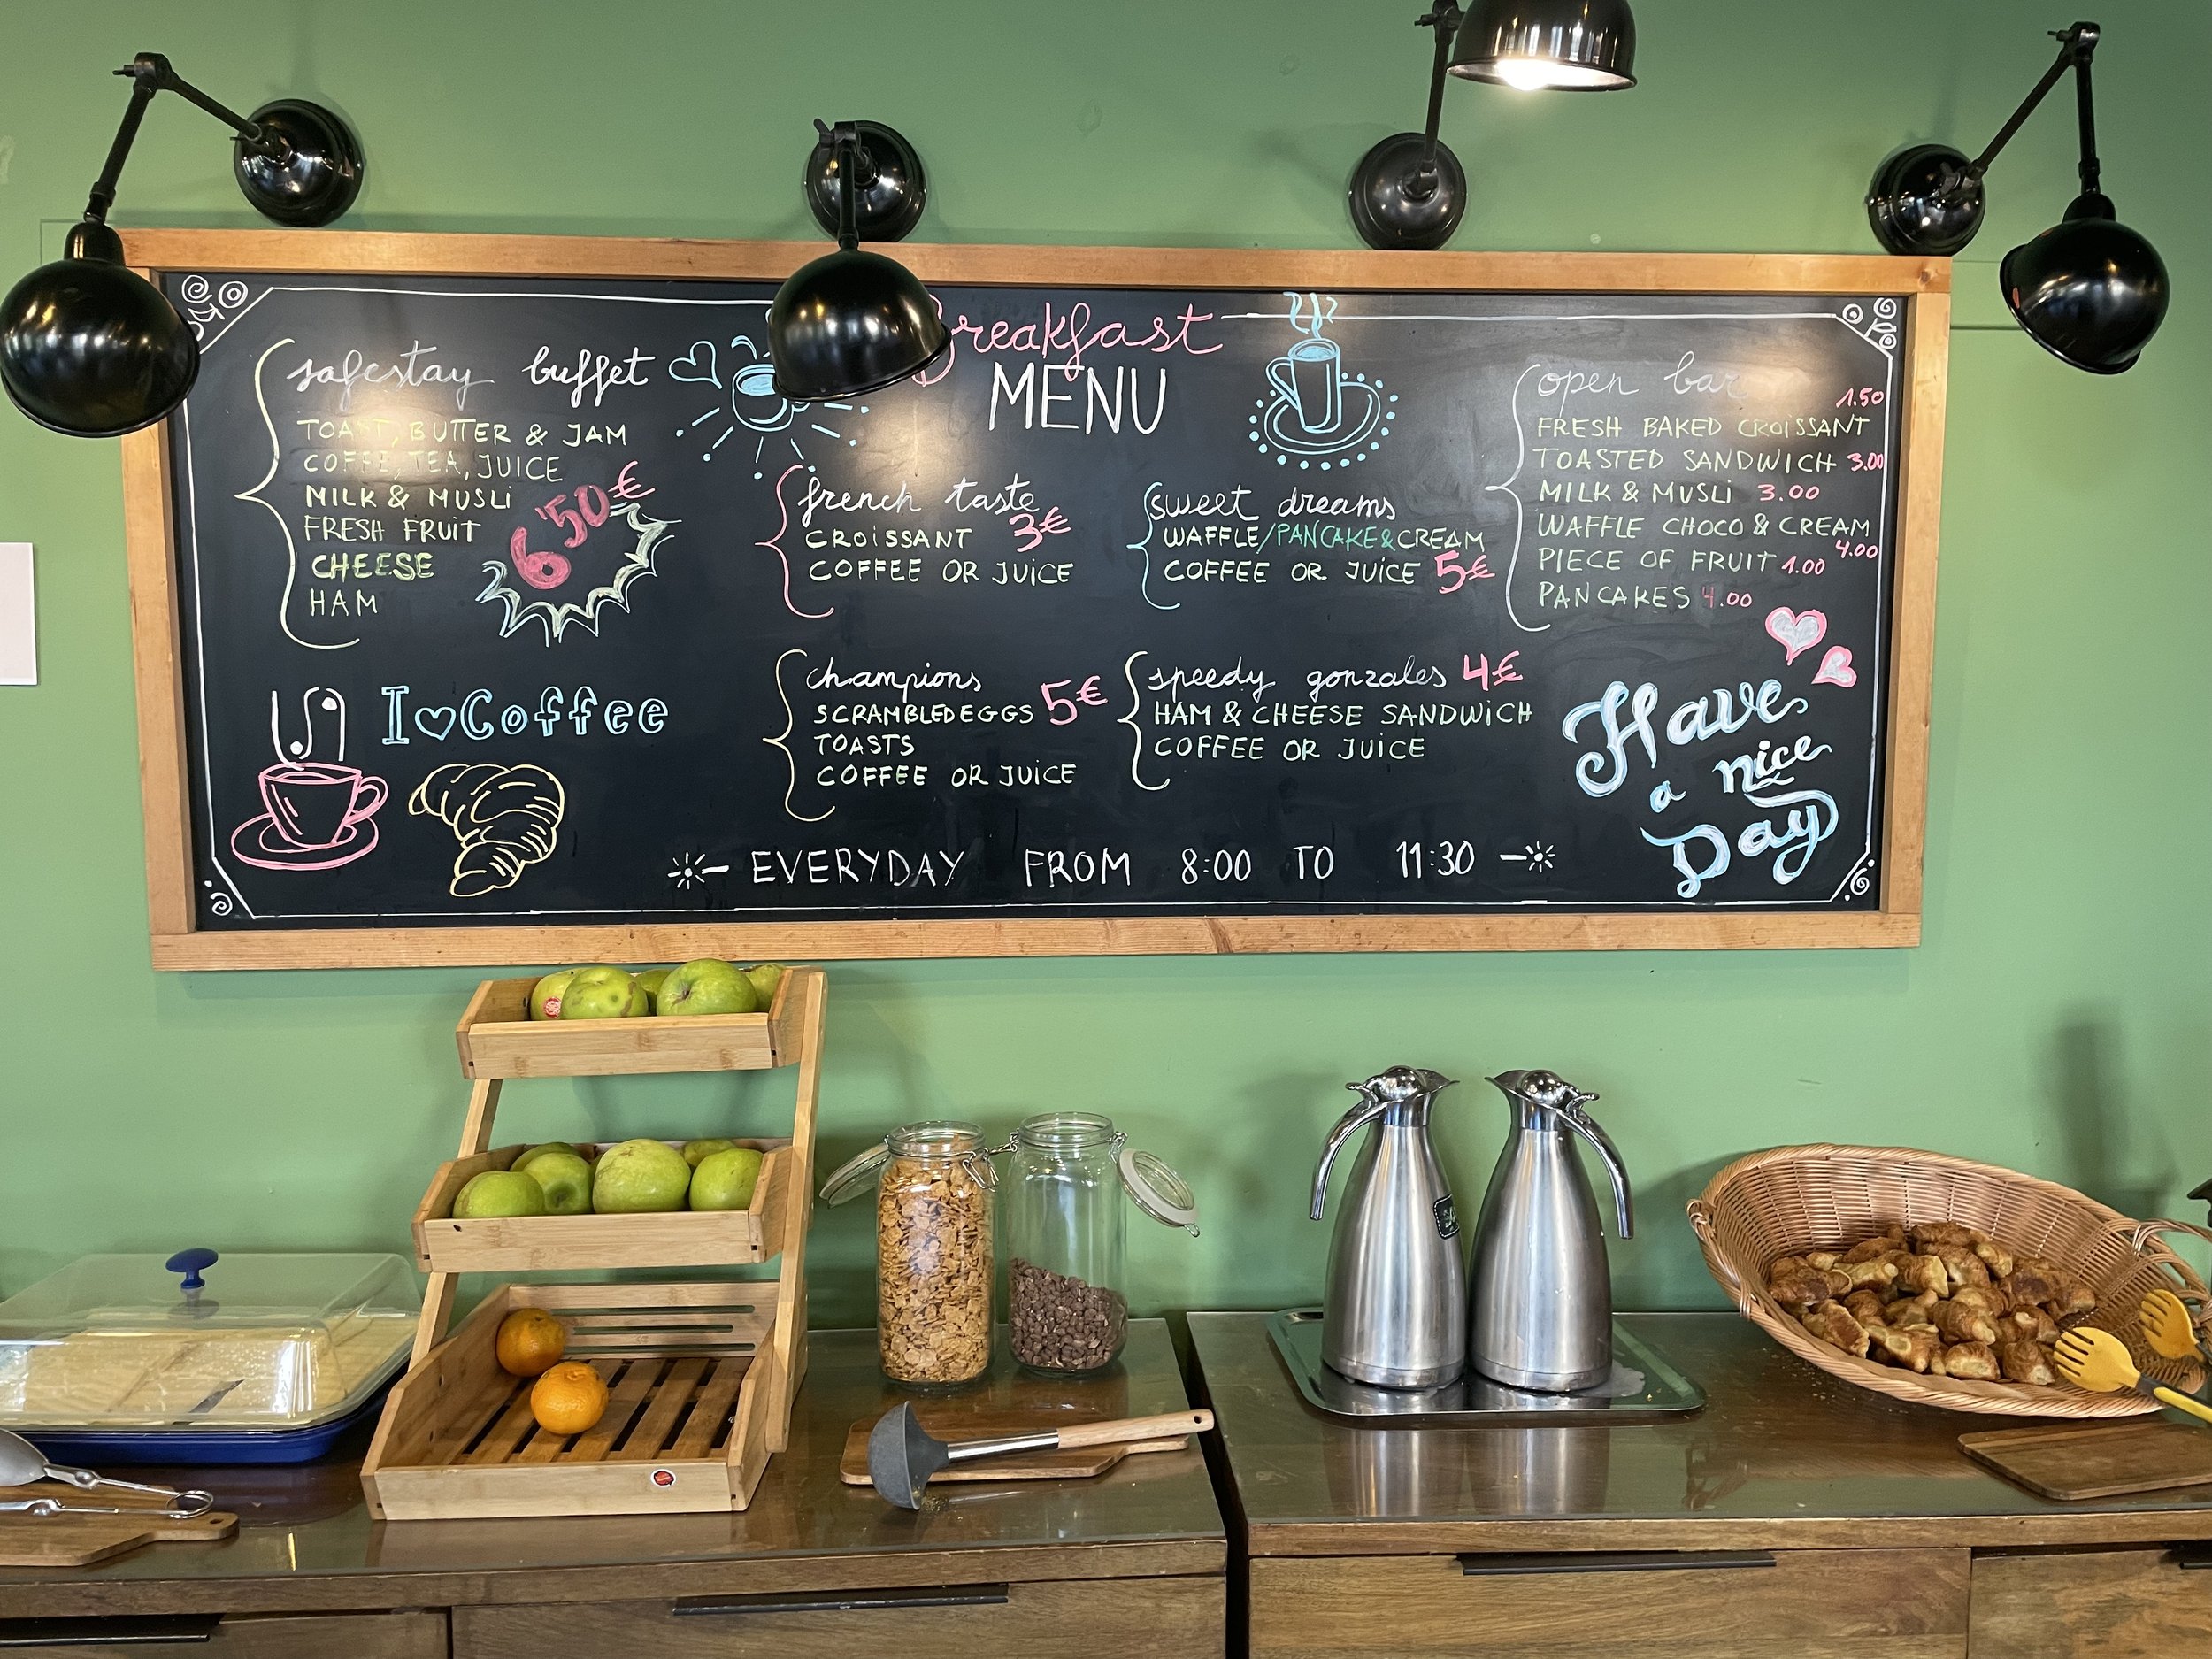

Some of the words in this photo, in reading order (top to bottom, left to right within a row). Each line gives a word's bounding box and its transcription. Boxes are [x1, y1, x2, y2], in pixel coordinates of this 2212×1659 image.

[521, 345, 656, 409] buffet
[1537, 369, 1640, 417] open
[1663, 350, 1748, 399] bar
[988, 361, 1166, 434] MENU
[1835, 388, 1884, 408] 1.50
[409, 419, 511, 444] BUTTER
[525, 424, 549, 447] &
[563, 423, 627, 448] JAM
[1538, 416, 1623, 438] FRESH
[1643, 415, 1722, 439] BAKED
[478, 453, 564, 483] JUICE
[1532, 448, 1664, 471] TOASTED
[1683, 449, 1837, 473] SANDWICH
[1846, 452, 1884, 472] 3.00
[306, 485, 377, 509] MILK
[388, 485, 411, 511] &
[798, 475, 922, 528] french
[944, 472, 1041, 515] taste
[1149, 483, 1260, 521] sweet
[1278, 486, 1397, 521] dreams
[1540, 479, 1612, 503] MILK
[1622, 480, 1640, 503] &
[1757, 484, 1821, 503] 3.00
[304, 515, 384, 542] FRESH
[1009, 506, 1071, 553] 3€
[1537, 513, 1645, 539] WAFFLE
[1662, 517, 1743, 537] CHOCO
[1752, 513, 1769, 537] &
[1778, 515, 1870, 538] CREAM
[1538, 547, 1624, 573] PIECE
[1640, 549, 1675, 570] OF
[1691, 548, 1777, 572] FRUIT
[1781, 556, 1825, 576] 1.00
[1835, 539, 1878, 559] 4.00
[312, 552, 435, 583] CHEESE
[809, 558, 922, 583] COFFEE
[942, 559, 980, 584] OR
[1163, 559, 1271, 584] COFFEE
[1290, 560, 1327, 583] OR
[1433, 549, 1495, 594] 5€
[310, 588, 379, 617] HAM
[1540, 580, 1691, 610] PANCAKES
[1701, 587, 1753, 609] 4.00
[1148, 655, 1277, 703] speedy
[1306, 654, 1447, 703] gonzales
[1462, 650, 1525, 692] 4€
[380, 685, 411, 745] I
[460, 685, 670, 741] Coffee
[1039, 674, 1109, 726] 5€
[1154, 700, 1212, 726] HAM
[1224, 699, 1243, 728] &
[1251, 702, 1363, 727] CHEESE
[813, 733, 915, 757] TOASTS
[1153, 735, 1265, 760] COFFEE
[1282, 737, 1321, 762] OR
[1561, 679, 1809, 798] Have
[815, 764, 928, 787] COFFEE
[950, 764, 989, 787] OR
[1648, 780, 1686, 814] a
[1711, 735, 1832, 794] nice
[1640, 789, 1840, 899] Day
[750, 847, 964, 887] EVERYDAY
[1025, 846, 1132, 887] FROM
[1180, 846, 1252, 885] 8:00
[1293, 844, 1334, 881] TO
[1395, 839, 1476, 880] 11:30
